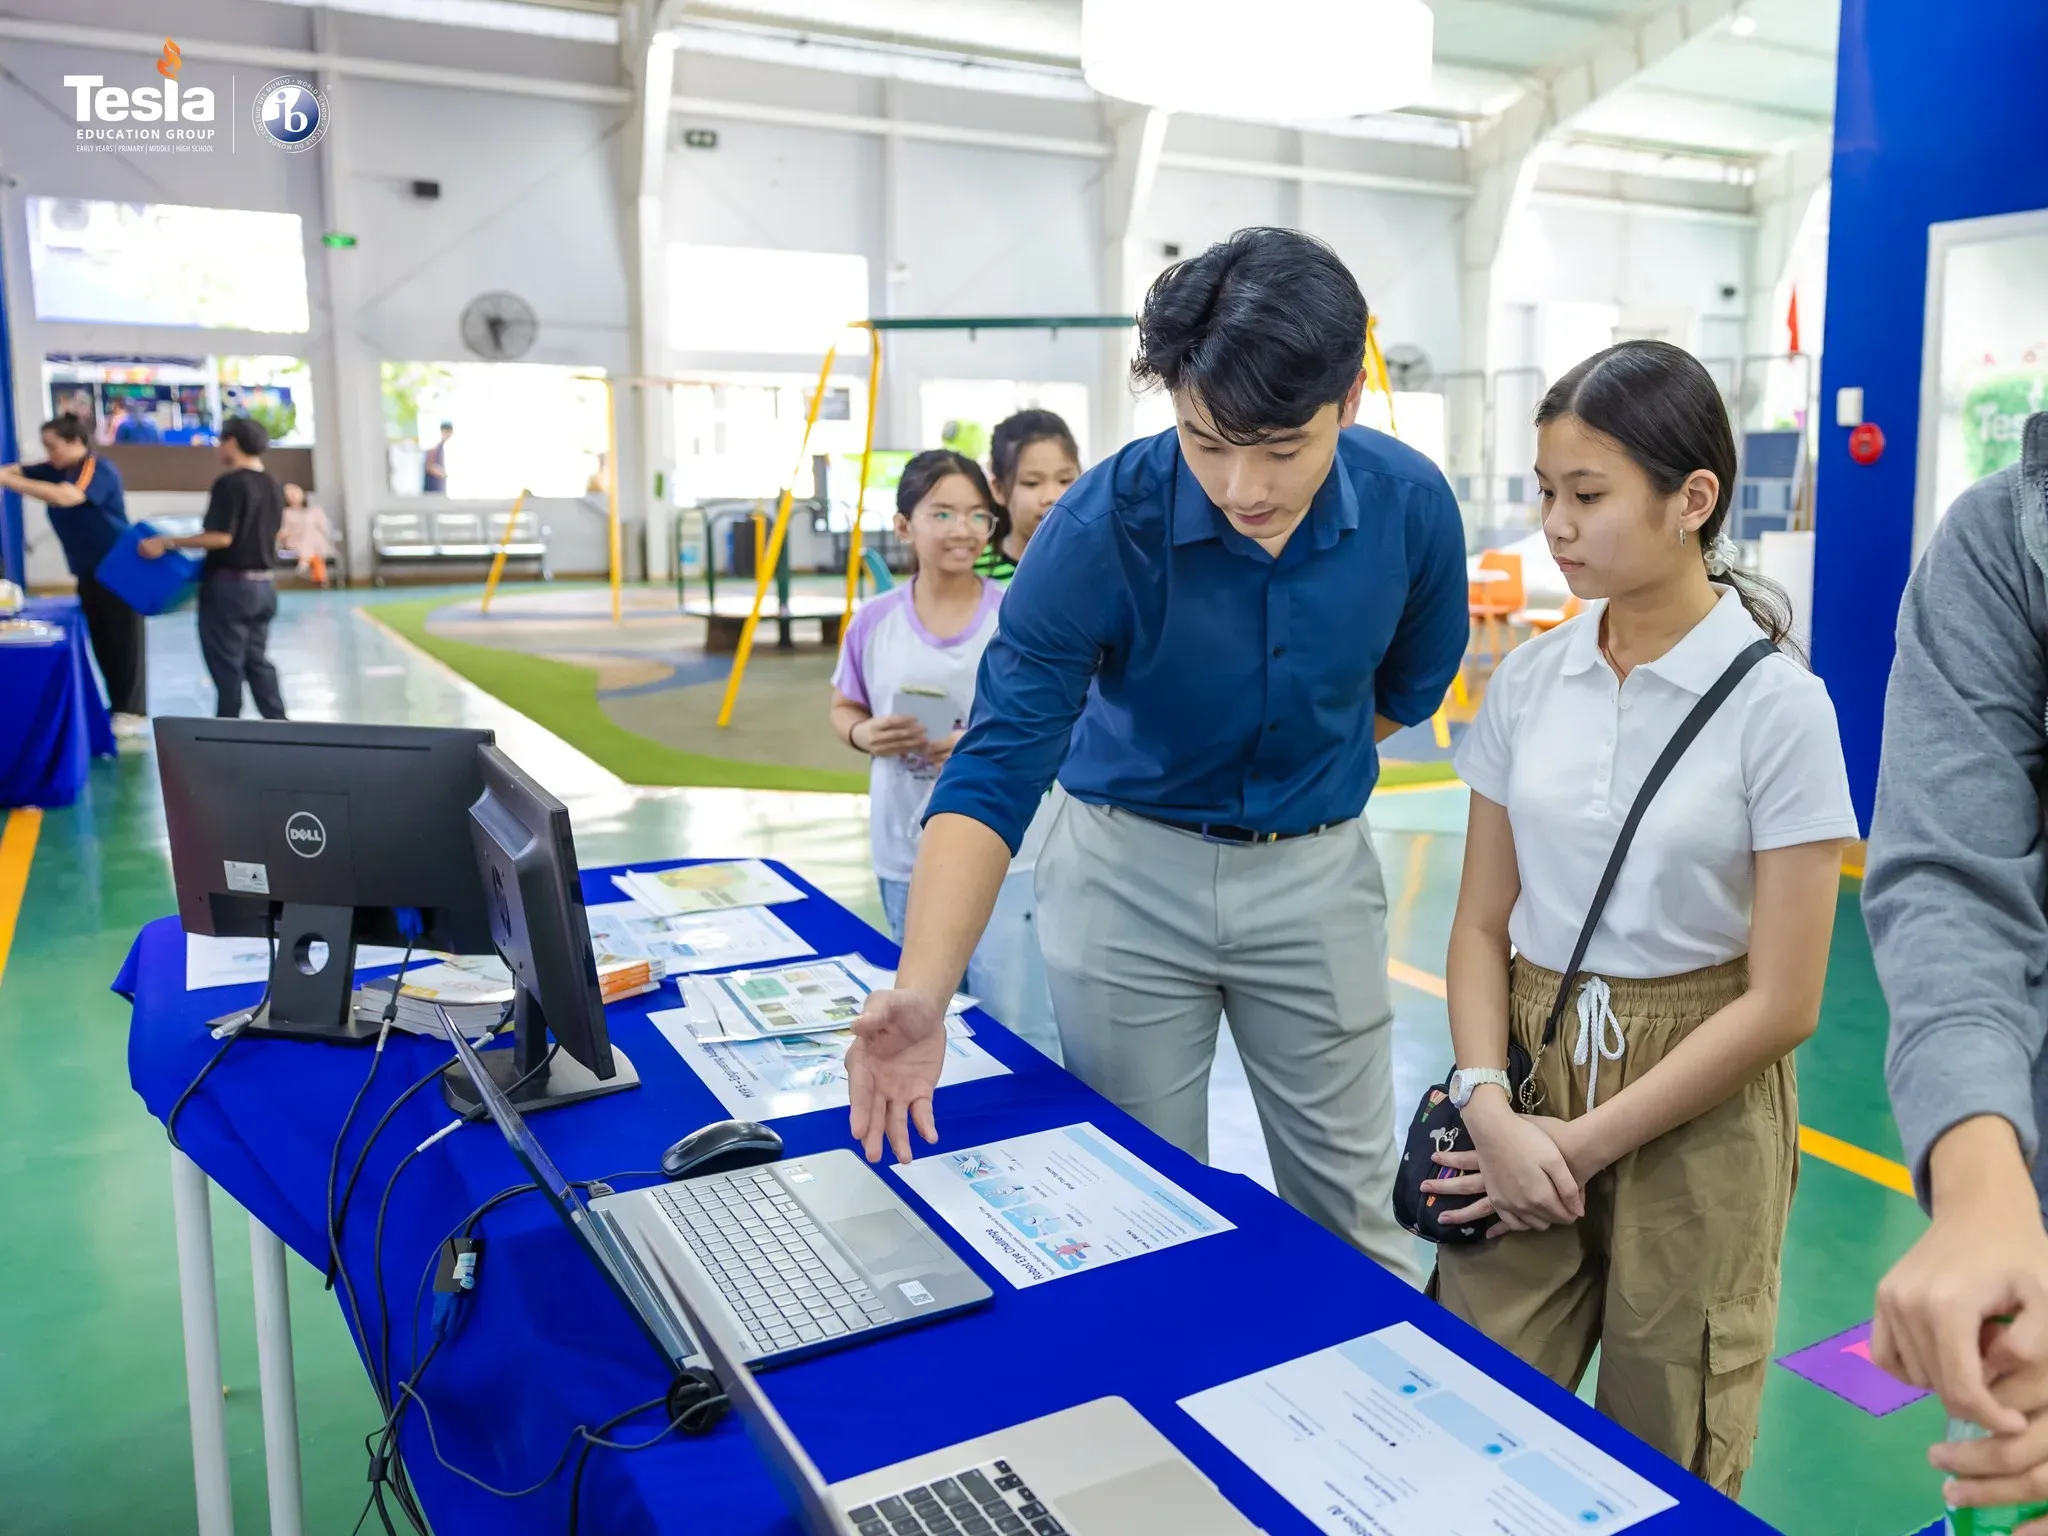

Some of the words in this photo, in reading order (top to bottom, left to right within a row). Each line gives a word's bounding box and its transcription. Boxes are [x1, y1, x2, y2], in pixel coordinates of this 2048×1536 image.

[1975, 402, 2026, 442] Tes
[290, 828, 322, 841] DELL
[985, 1228, 1015, 1253] Challenge
[1012, 1253, 1027, 1264] Eye
[1021, 1262, 1044, 1280] Robot
